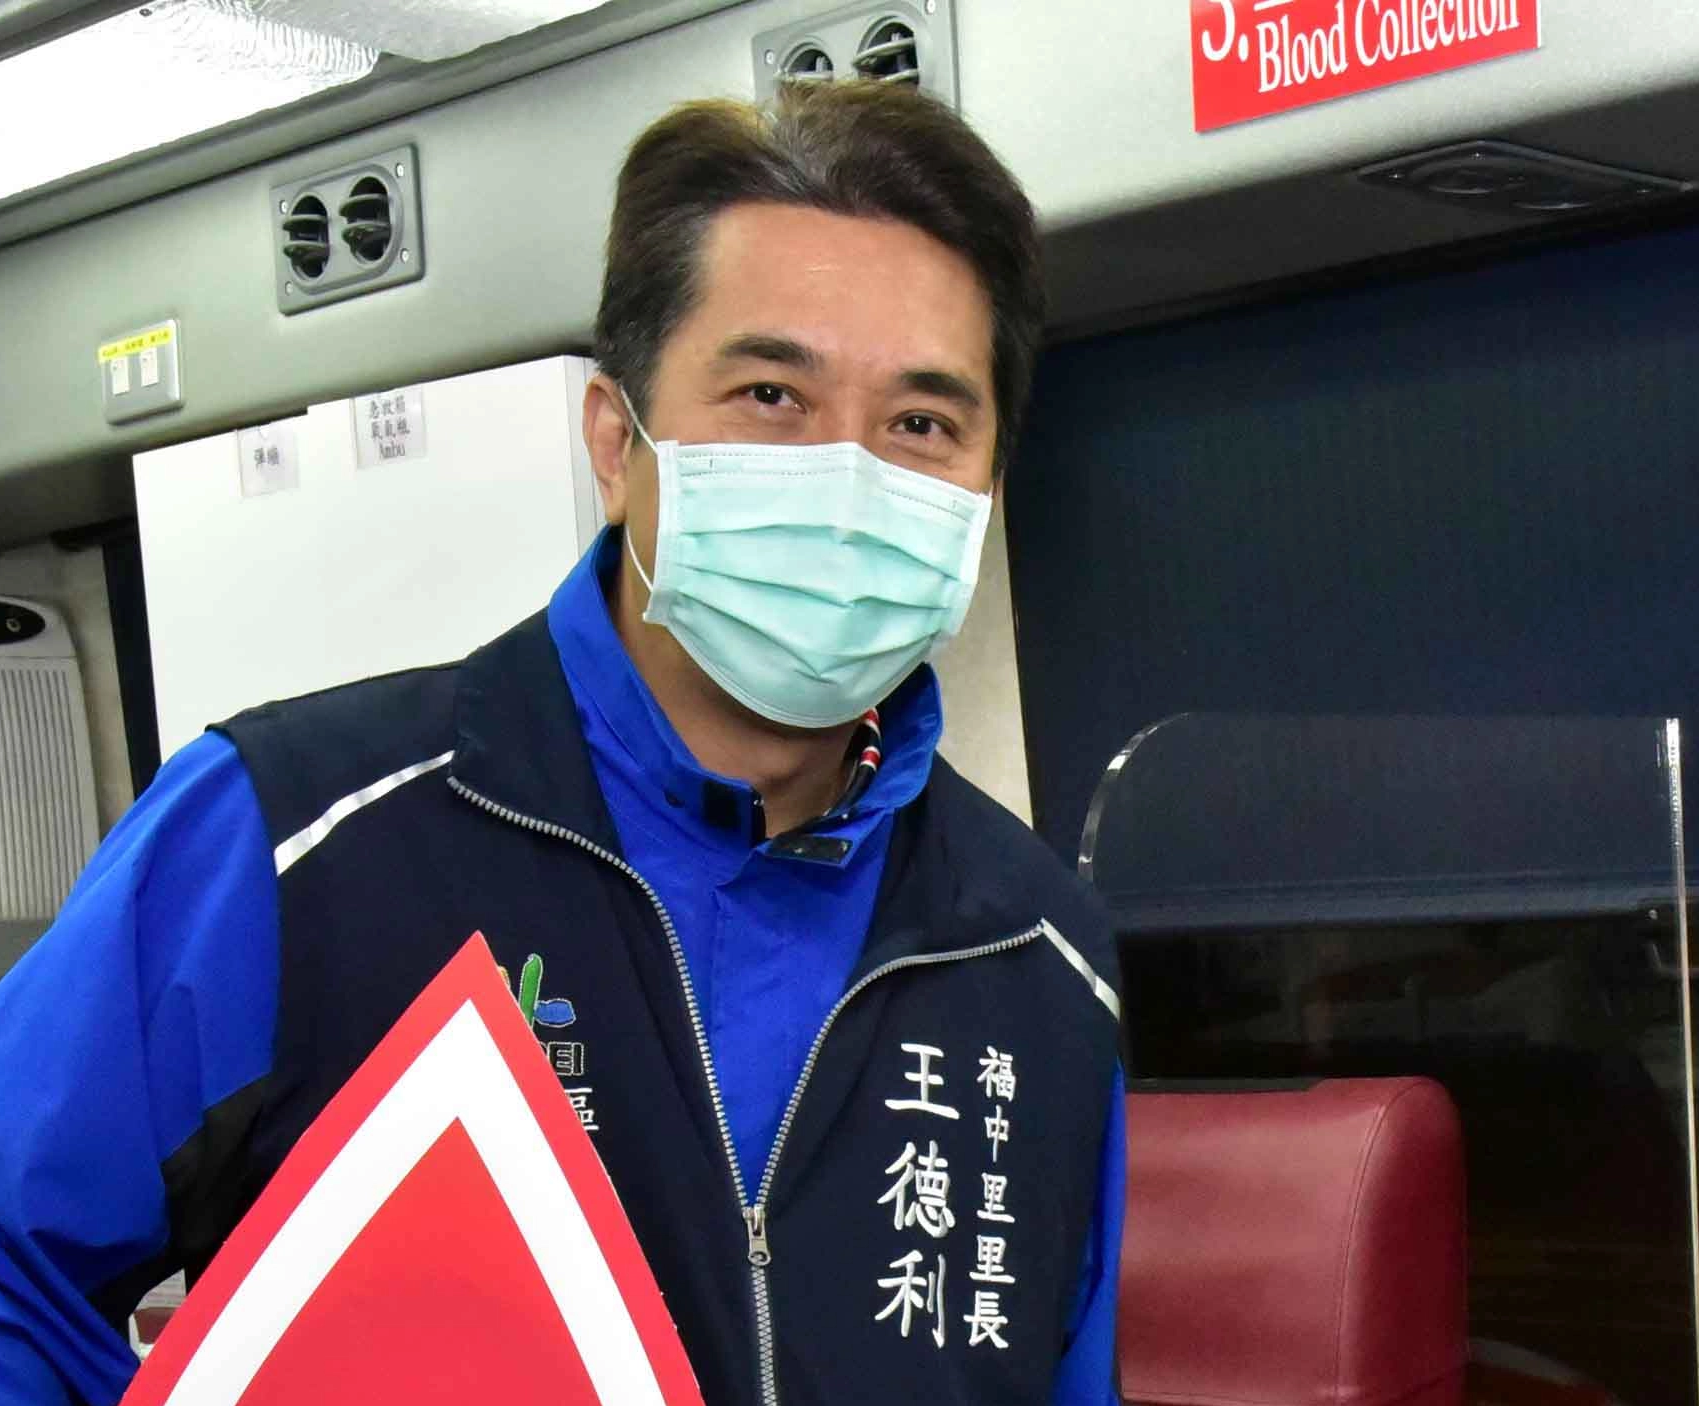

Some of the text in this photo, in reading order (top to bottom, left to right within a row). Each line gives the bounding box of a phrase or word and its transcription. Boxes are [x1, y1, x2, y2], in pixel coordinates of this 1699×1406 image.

[1255, 3, 1349, 94] Blood
[540, 1041, 585, 1077] EI
[875, 1041, 961, 1348] 王德利
[963, 1044, 1017, 1351] 福中里里長
